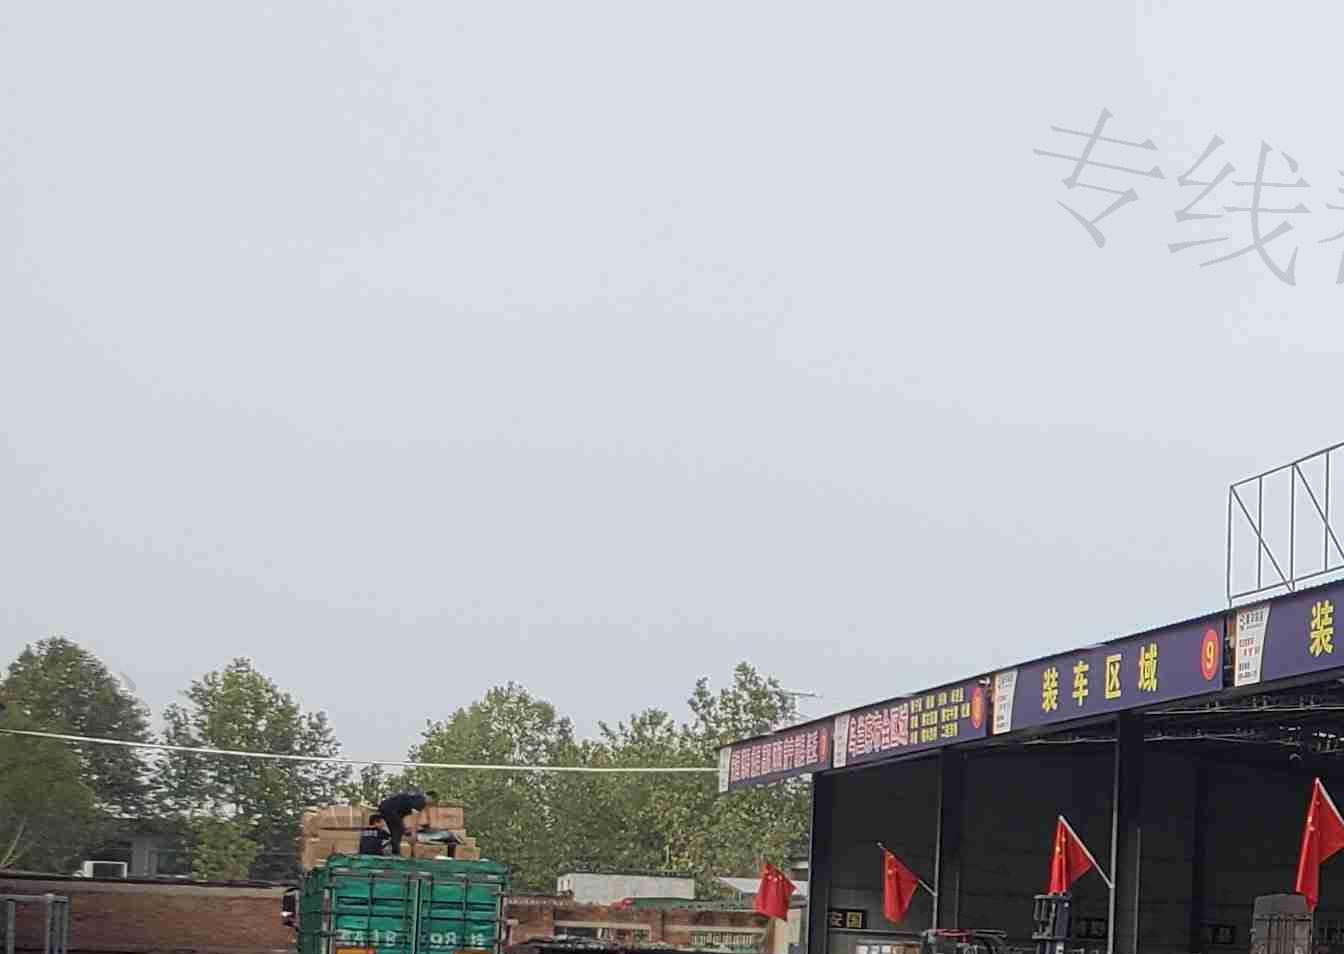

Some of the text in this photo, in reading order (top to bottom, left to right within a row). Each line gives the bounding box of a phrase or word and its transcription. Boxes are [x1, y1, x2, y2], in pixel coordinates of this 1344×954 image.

[1041, 641, 1158, 713] 装车区域
[1206, 641, 1214, 668] 9
